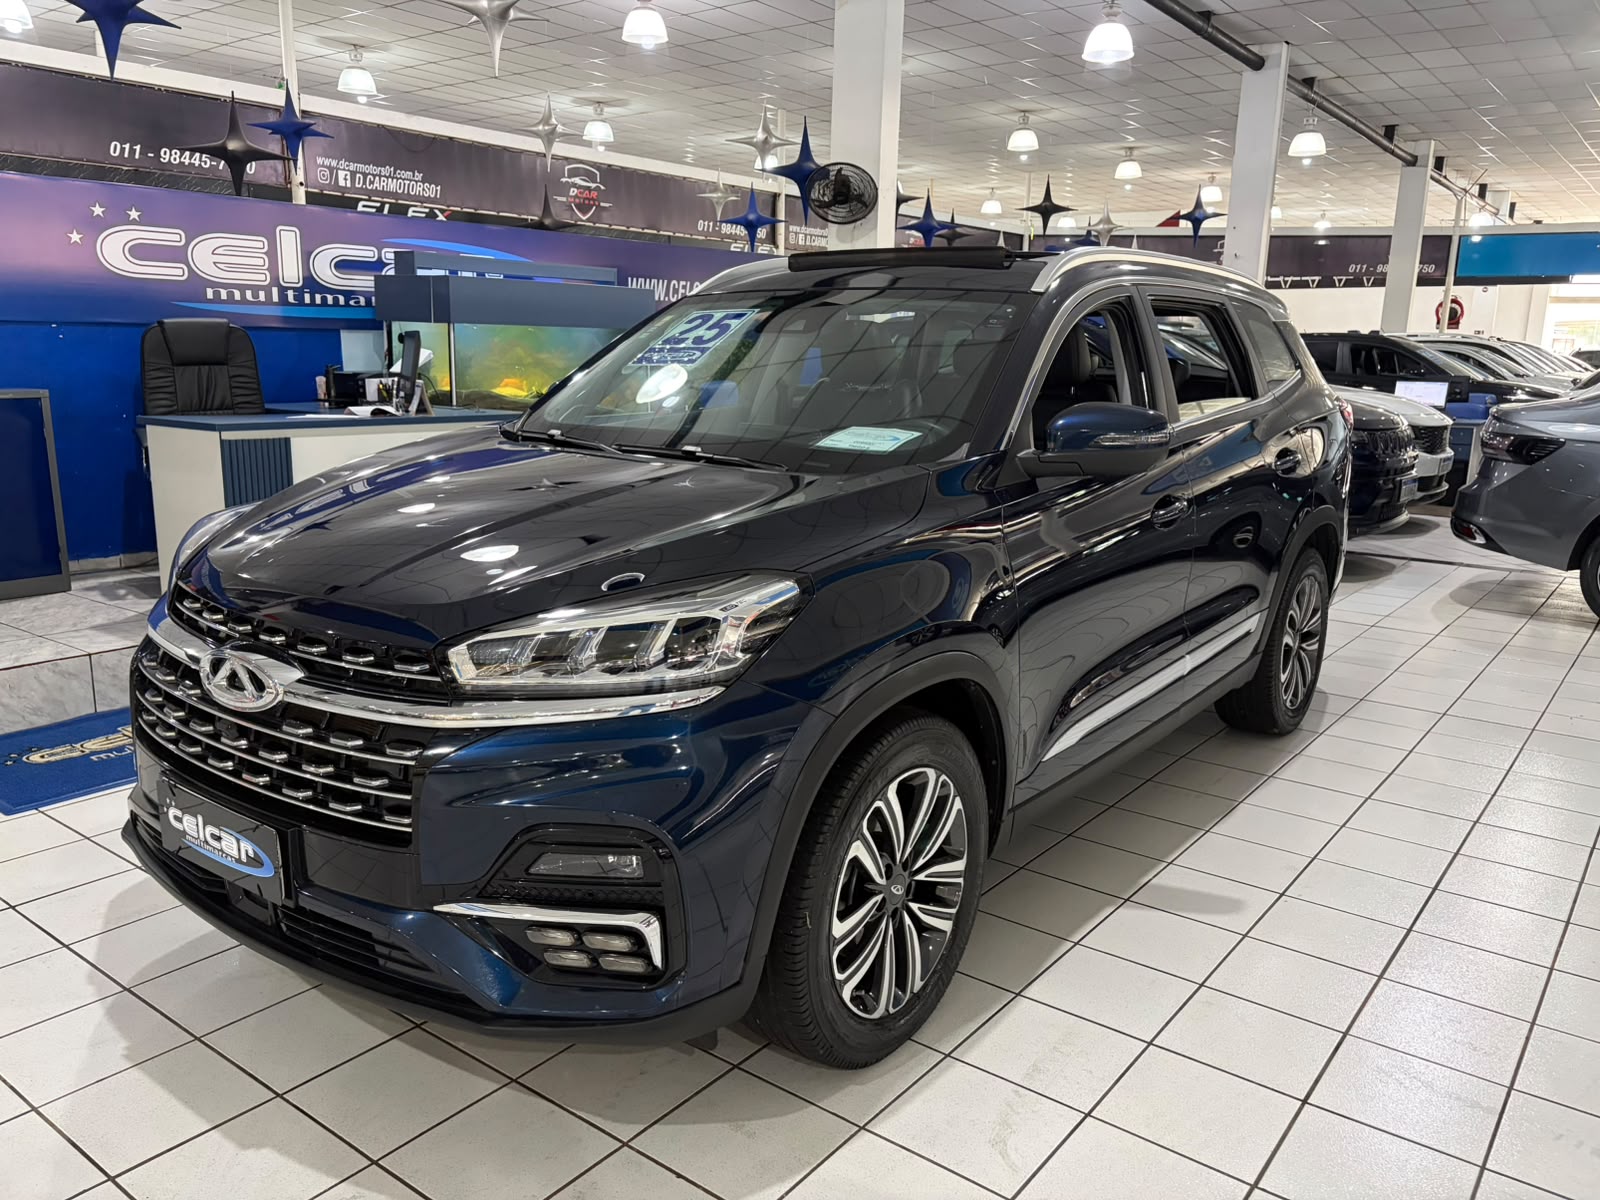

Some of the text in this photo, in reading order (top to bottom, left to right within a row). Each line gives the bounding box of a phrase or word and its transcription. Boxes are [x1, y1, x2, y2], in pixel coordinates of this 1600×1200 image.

[110, 141, 141, 159] 011
[159, 148, 256, 175] 98445-70
[316, 156, 424, 181] www.dcarmotors01.com.br
[355, 174, 441, 198] D.CARMOTORS01
[569, 187, 598, 199] DCAR
[697, 220, 713, 232] 011
[721, 222, 767, 239] 98445-50
[96, 225, 504, 290] celc
[1349, 263, 1367, 273] 011
[661, 312, 749, 346] 25
[168, 806, 255, 862] celcar
